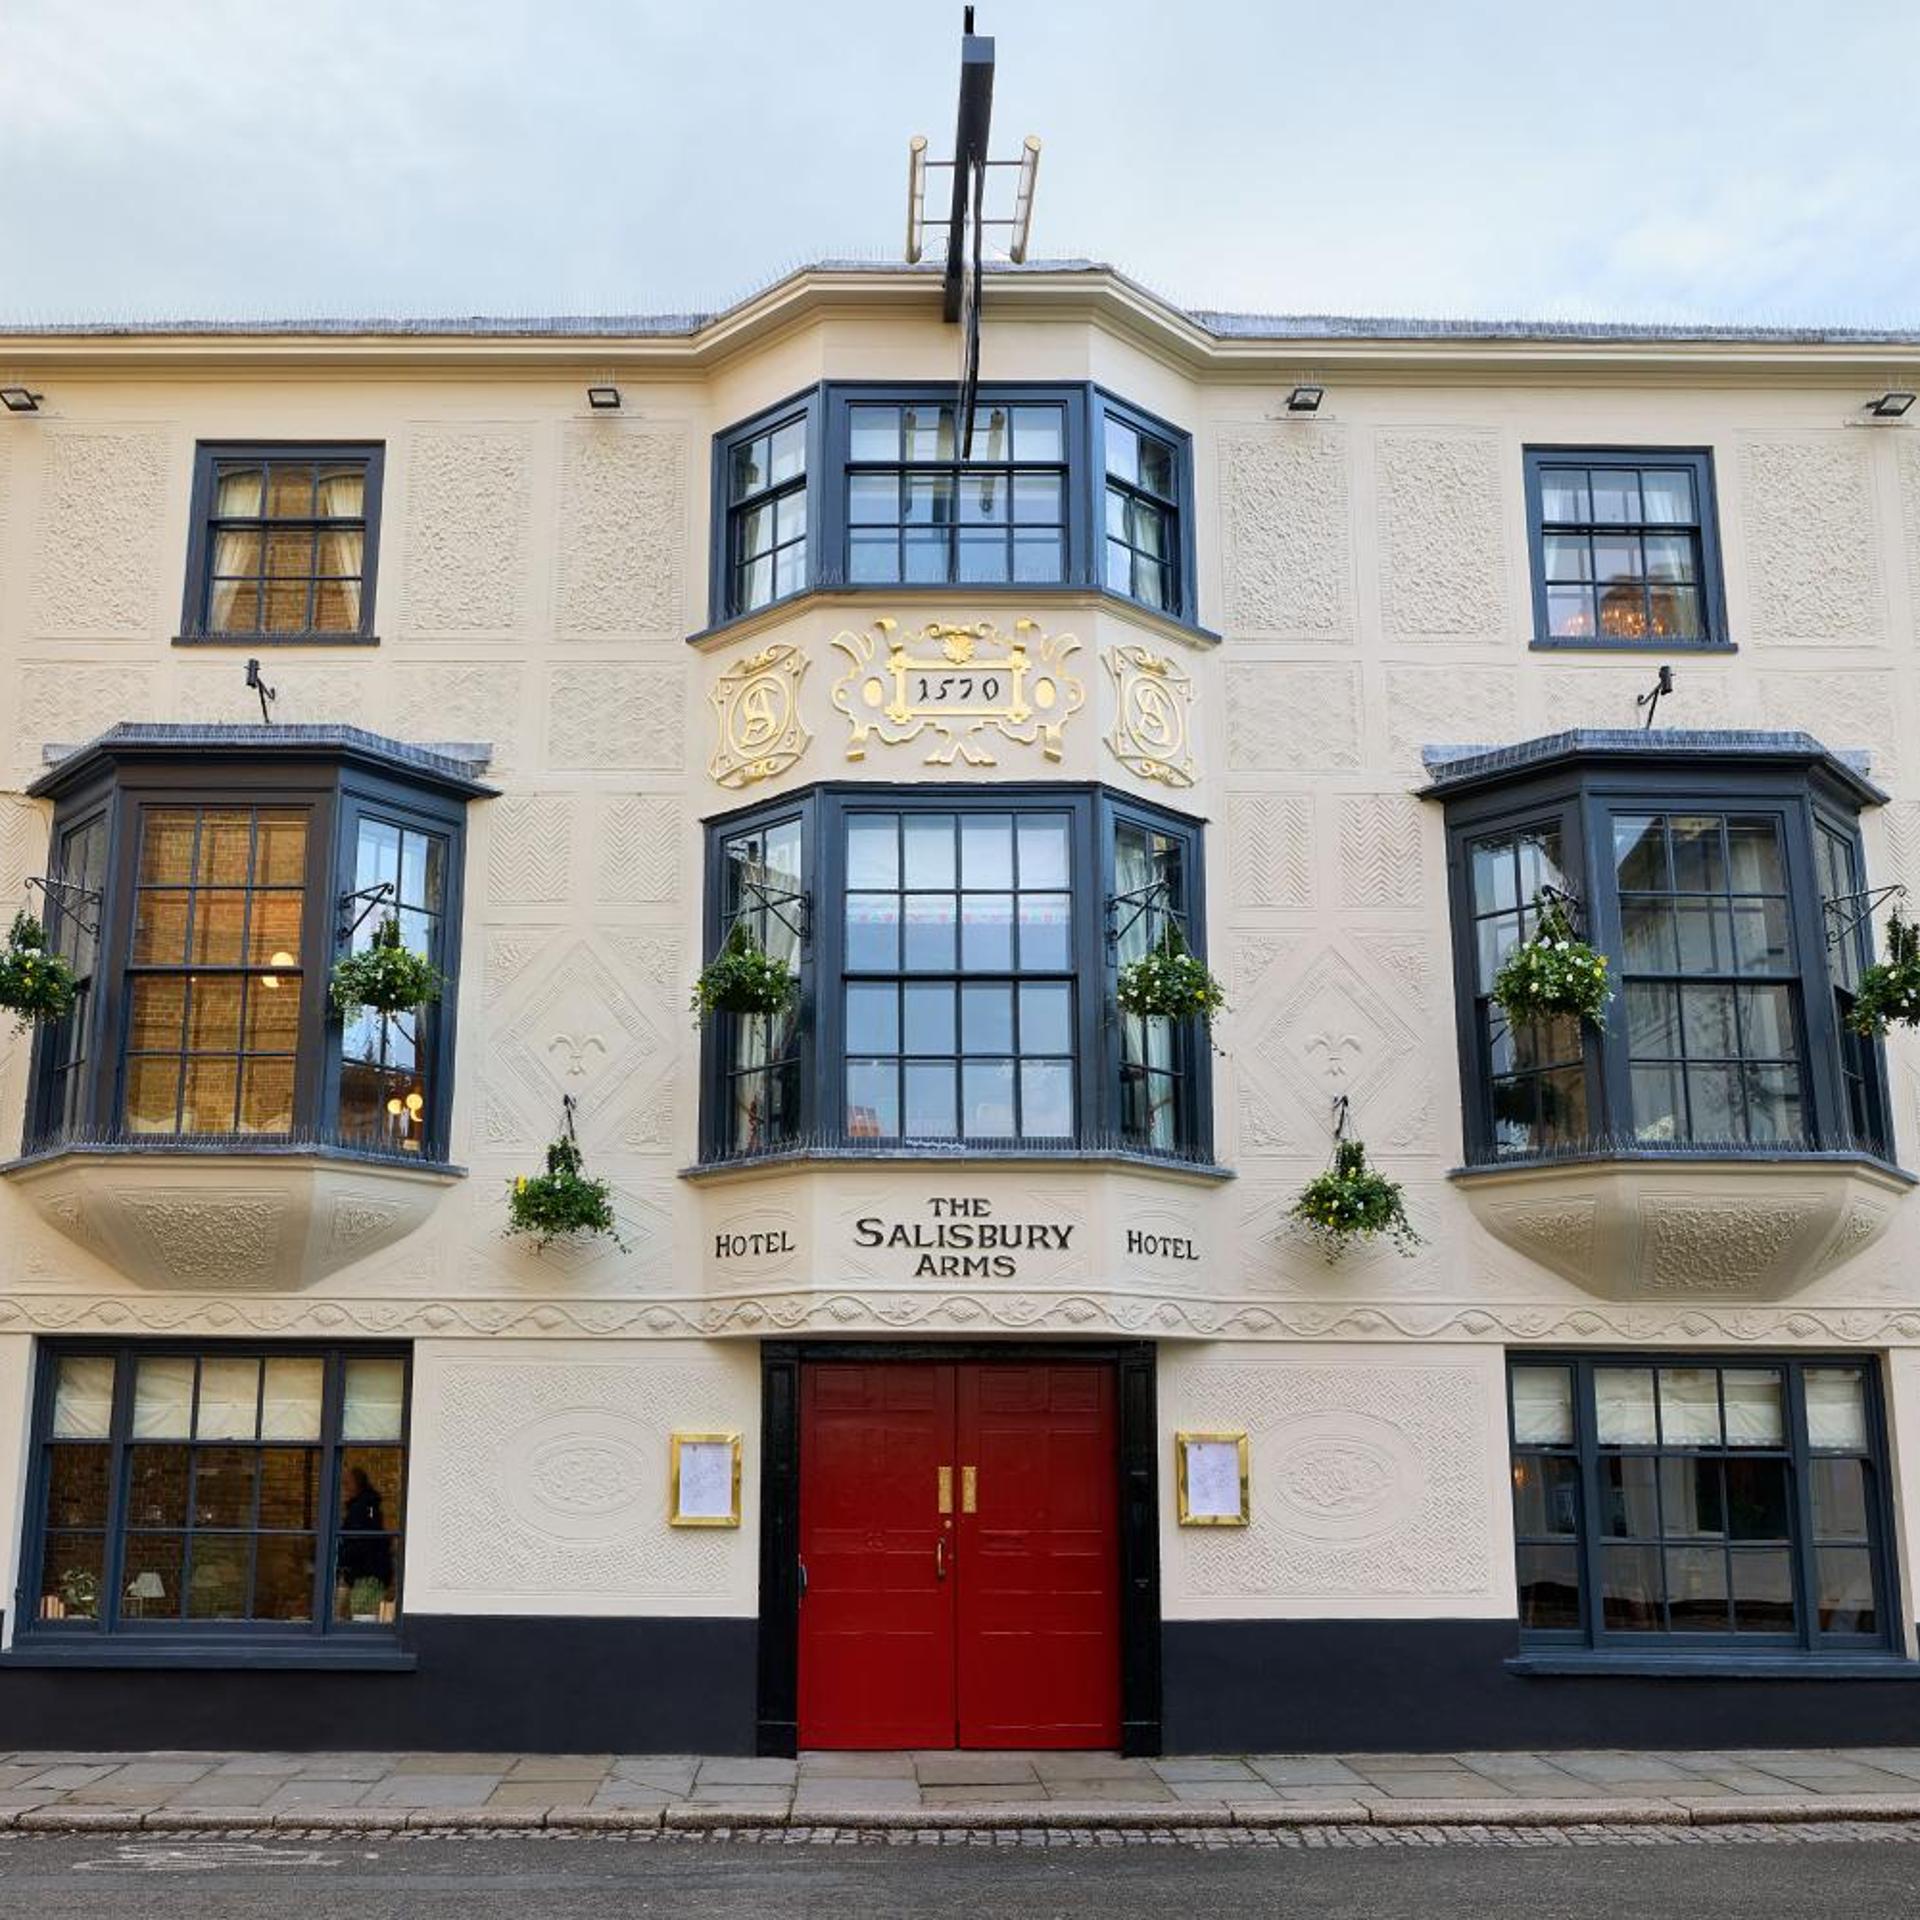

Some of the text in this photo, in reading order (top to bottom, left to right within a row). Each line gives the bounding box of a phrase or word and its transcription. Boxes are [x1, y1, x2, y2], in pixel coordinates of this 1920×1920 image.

[918, 677, 1000, 702] 1570
[928, 1197, 991, 1218] THE
[714, 1230, 796, 1259] HOTEL
[854, 1218, 1075, 1251] SALISBURY
[1126, 1230, 1200, 1261] HOTEL
[914, 1254, 1017, 1279] ARMS
